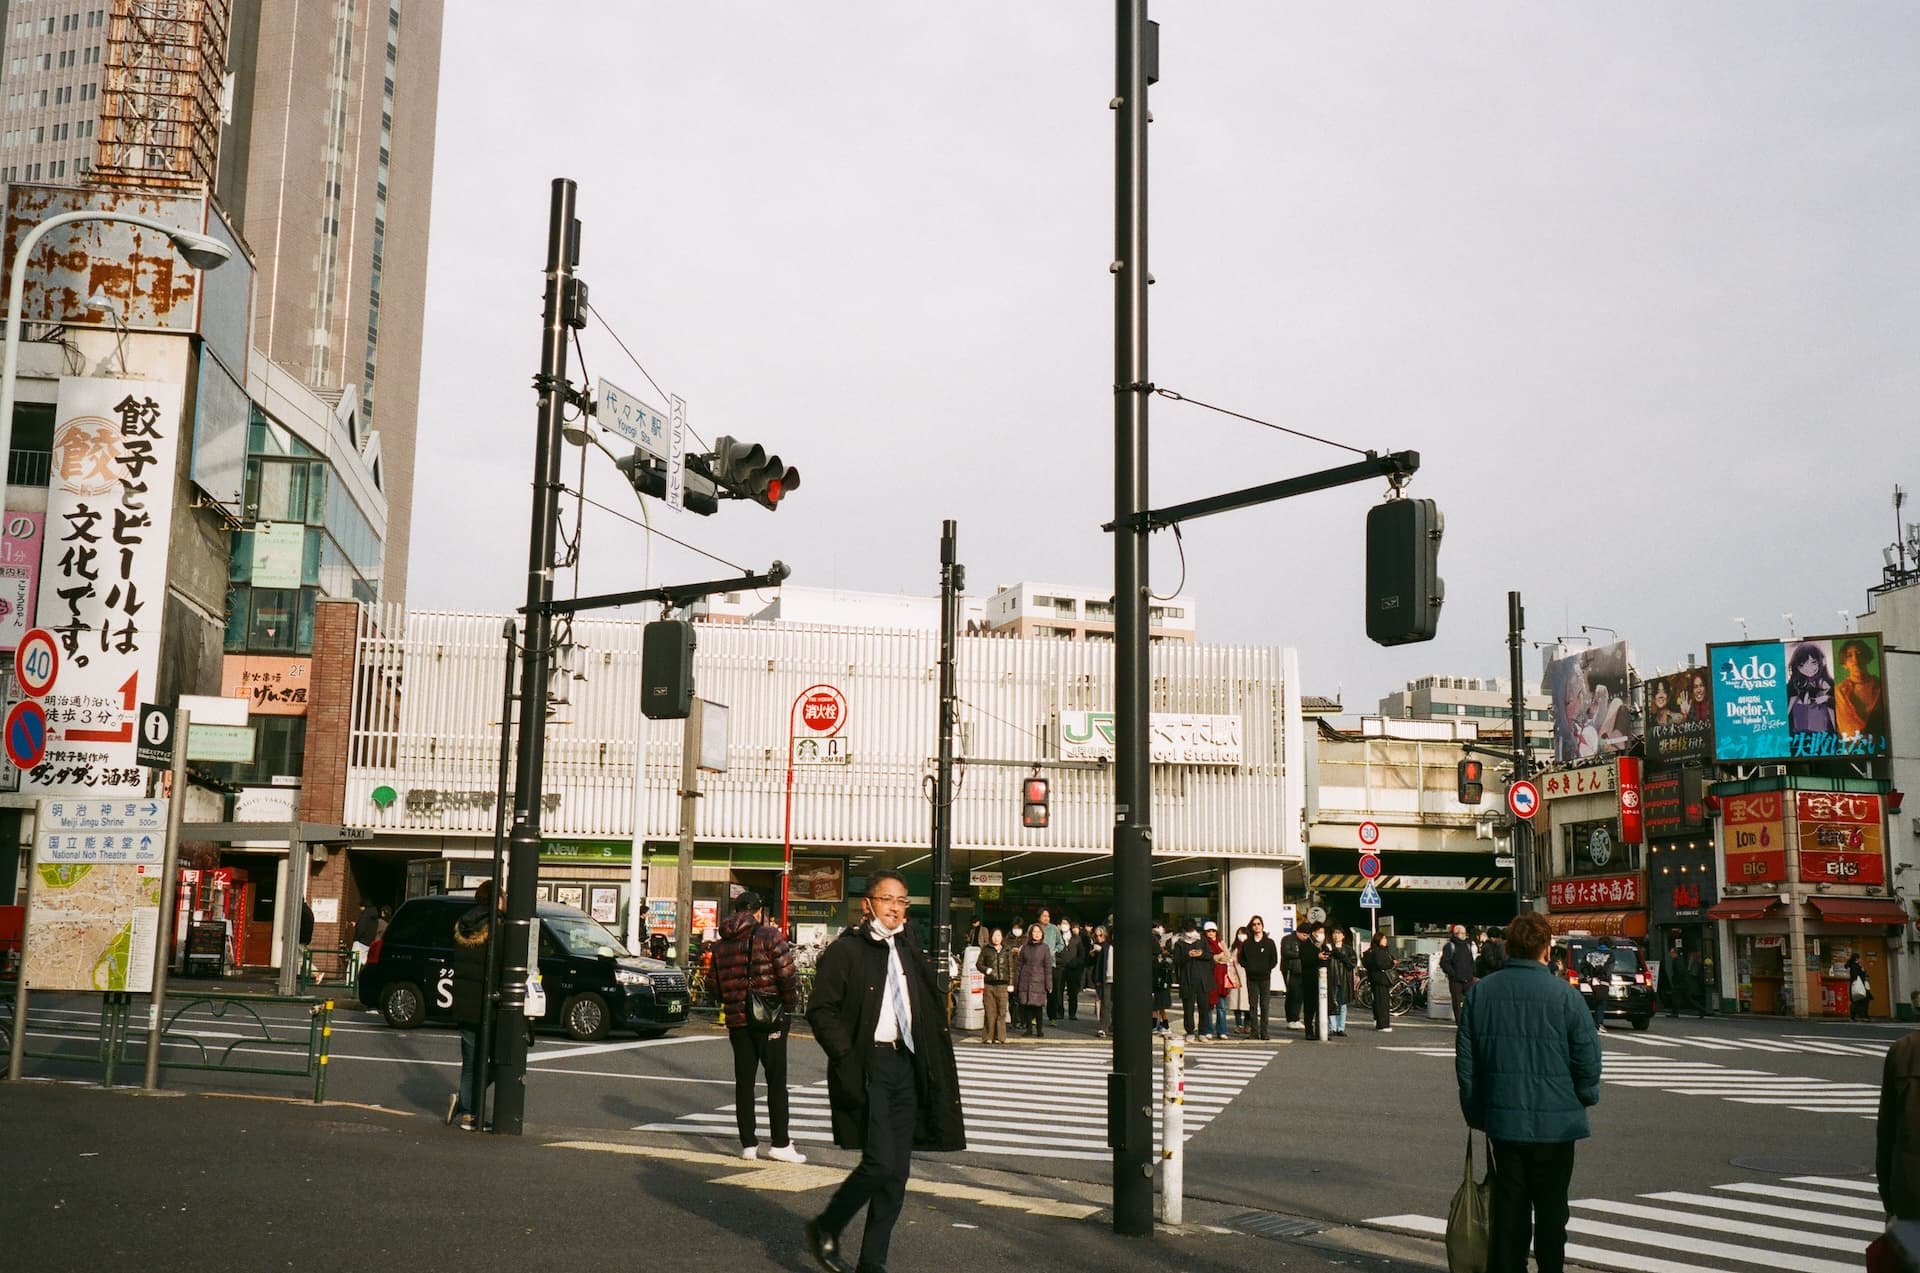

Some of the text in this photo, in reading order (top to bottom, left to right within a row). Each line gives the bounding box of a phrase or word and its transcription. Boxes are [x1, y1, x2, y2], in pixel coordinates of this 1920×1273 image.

[606, 390, 662, 438] 代々木駅
[617, 417, 638, 438] Yoyogi
[101, 394, 164, 655] 餃子とビールは
[54, 504, 103, 669] 文化です。
[25, 647, 50, 680] 40
[290, 664, 305, 677] 2F
[1720, 655, 1777, 682] Ado
[1741, 679, 1777, 691] Ayase
[805, 703, 838, 720] 消火栓
[1726, 700, 1775, 717] Doctor-X
[43, 750, 109, 763] 汁餃子製作所
[1546, 770, 1602, 795] やきとん
[51, 803, 137, 817] 明治神宮
[1730, 796, 1775, 822] 宝くじ
[1807, 794, 1868, 820] 宝くじ
[60, 818, 78, 829] Meiji
[79, 817, 99, 828] Jingu
[101, 817, 125, 827] Shrine
[347, 828, 365, 839] TAXI
[1363, 827, 1374, 839] 30
[1736, 830, 1757, 849] LOTO
[48, 835, 134, 849] 国立能楽堂
[51, 850, 80, 860] National
[82, 850, 97, 859] Noh
[99, 850, 127, 860] Theatre
[1743, 861, 1768, 876] BIG
[1826, 861, 1859, 876] BIG
[1577, 878, 1636, 903] たまや商店
[436, 977, 454, 1008] S
